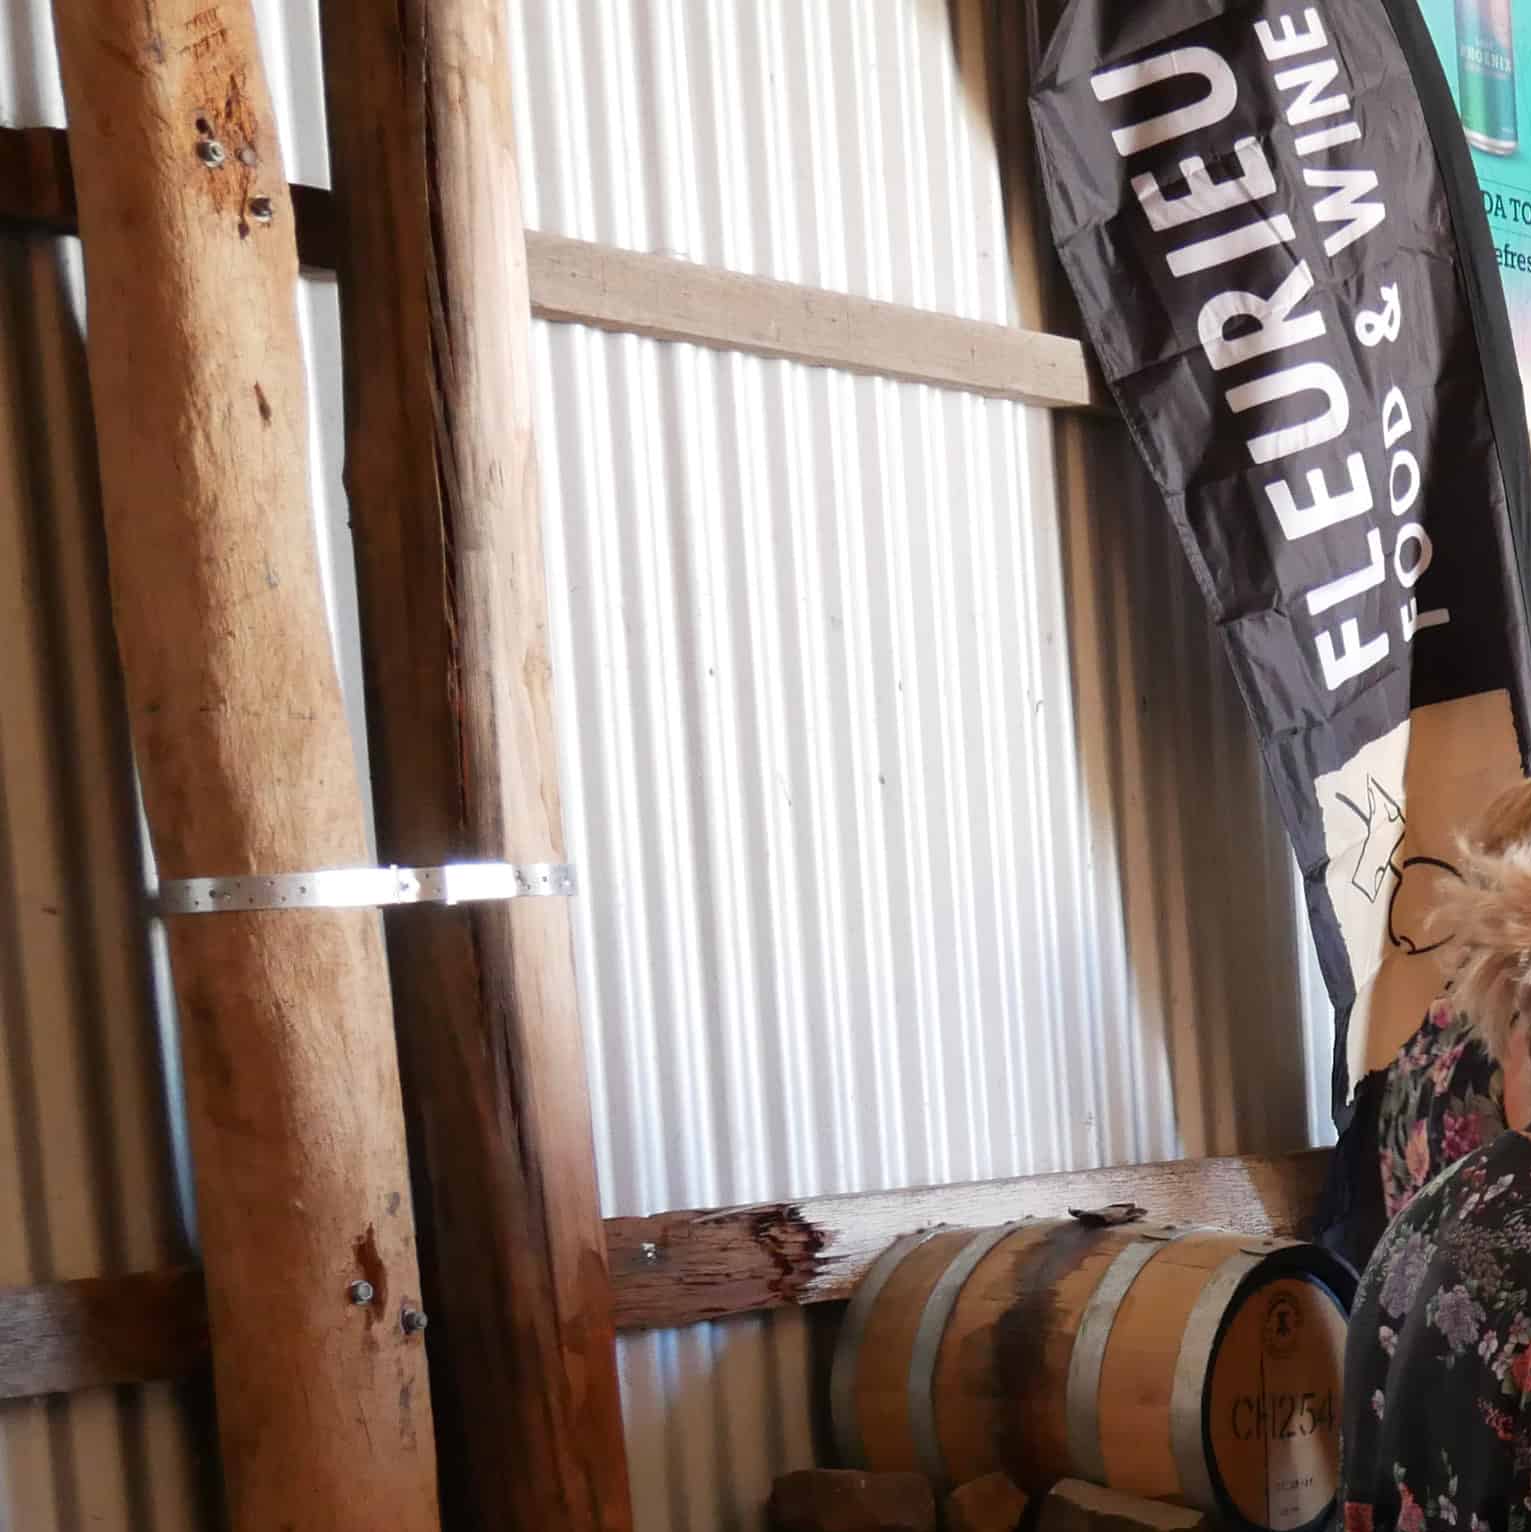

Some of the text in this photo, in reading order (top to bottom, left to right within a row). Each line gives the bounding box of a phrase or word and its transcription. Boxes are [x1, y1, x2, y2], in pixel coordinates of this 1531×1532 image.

[1091, 45, 1390, 692] FLEURIEU
[1254, 6, 1450, 643] FOOD & WINE
[1481, 191, 1507, 221] DA
